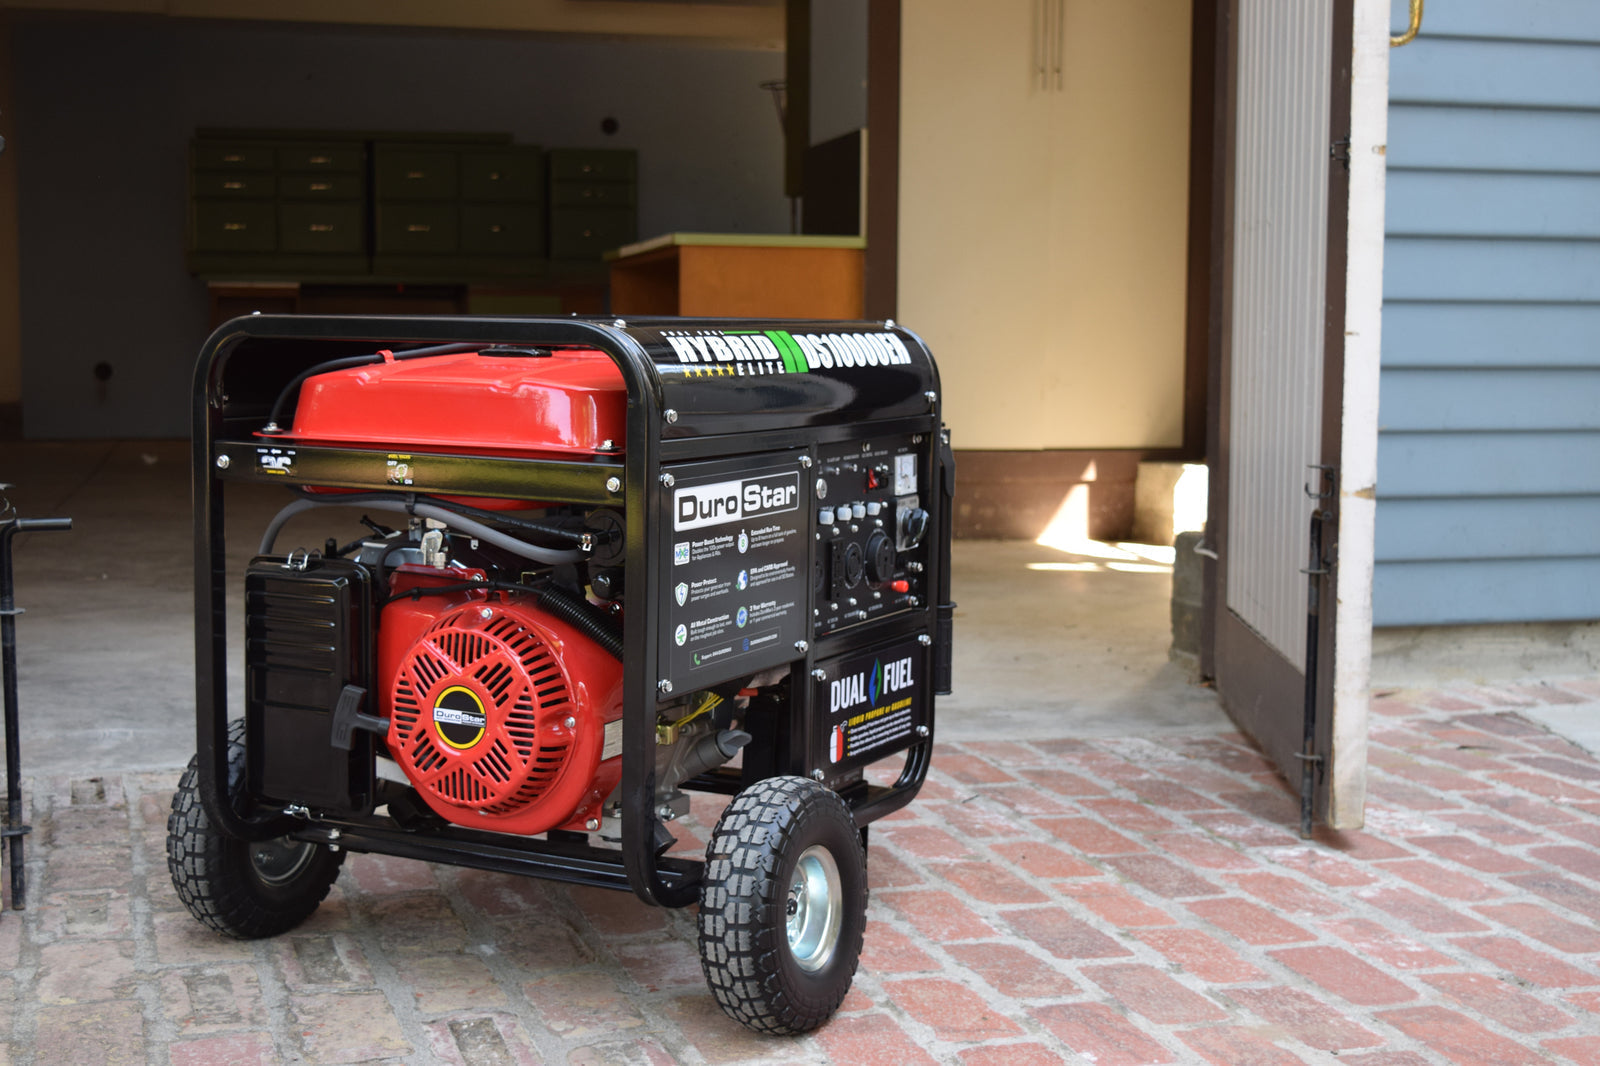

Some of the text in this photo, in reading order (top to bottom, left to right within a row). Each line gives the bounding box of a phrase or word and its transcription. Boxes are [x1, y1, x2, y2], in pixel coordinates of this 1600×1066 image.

[666, 332, 912, 369] HYBRID DS10000EH
[737, 361, 785, 376] ELITE
[830, 657, 914, 713] DUAL FUEL
[436, 710, 485, 723] DuroStar
[865, 706, 885, 720] PROPANE
